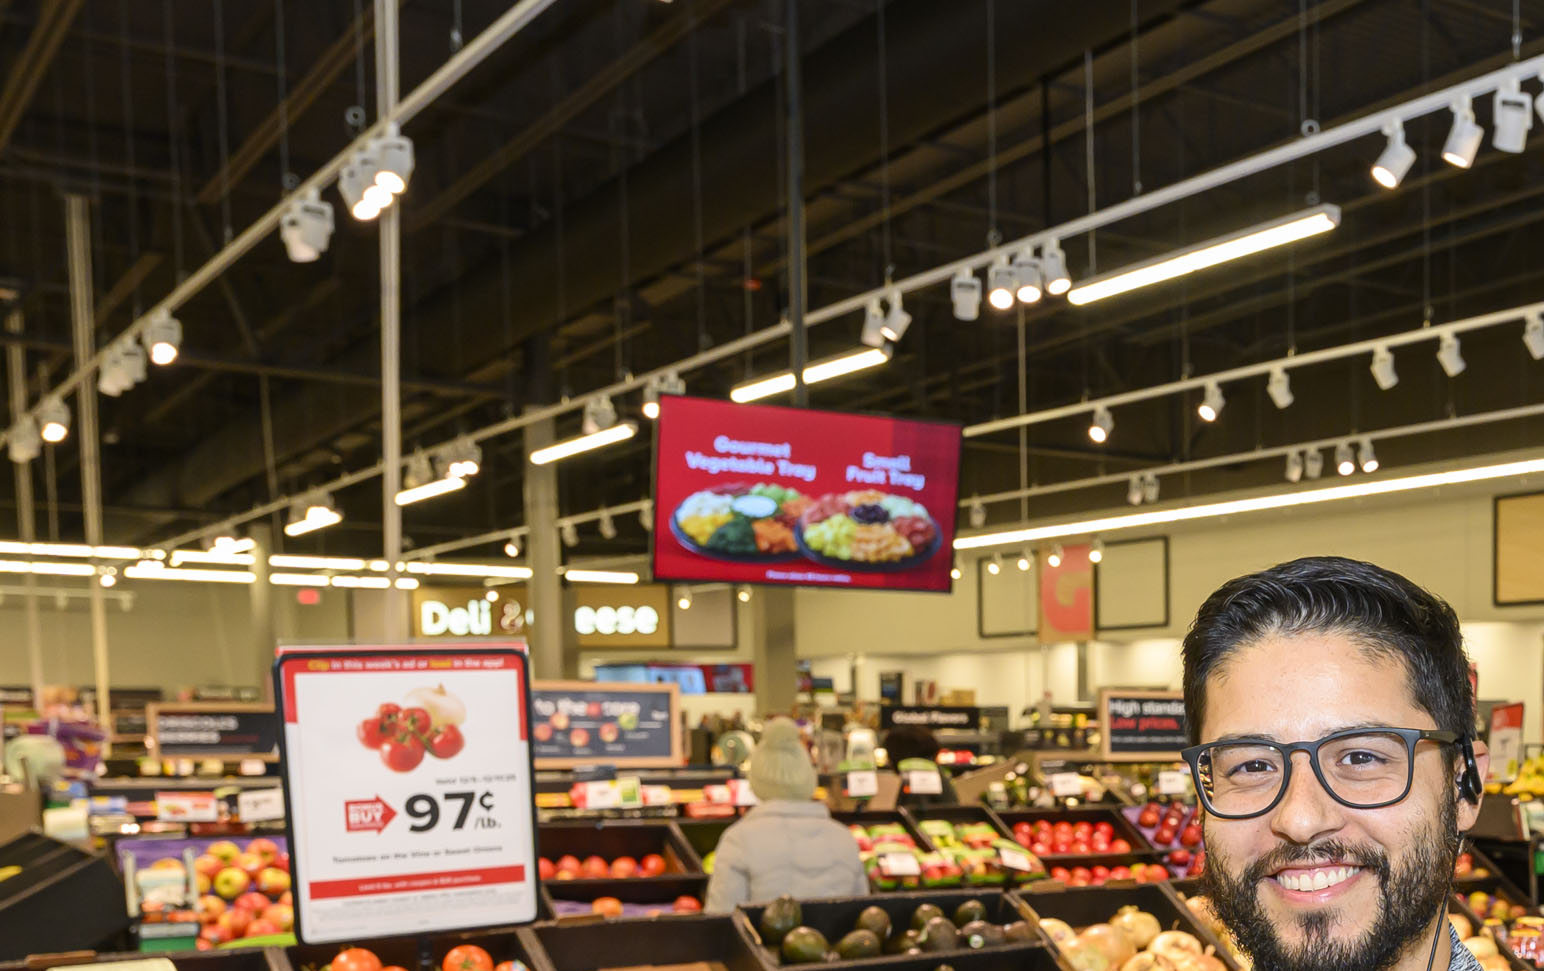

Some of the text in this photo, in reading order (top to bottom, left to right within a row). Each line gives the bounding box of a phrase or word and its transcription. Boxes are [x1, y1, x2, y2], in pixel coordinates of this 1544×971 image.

[714, 435, 791, 458] Gourmet
[685, 451, 817, 482] Vegetable Tray
[862, 452, 911, 471] Small
[846, 465, 925, 490] Fruit Tray
[421, 600, 491, 635] Deli
[500, 600, 524, 634] &
[343, 660, 363, 669] this
[464, 659, 480, 667] the
[891, 710, 970, 724] Global Flavors
[1109, 700, 1140, 717] High
[1110, 715, 1136, 730] Low
[350, 811, 383, 825] BUY
